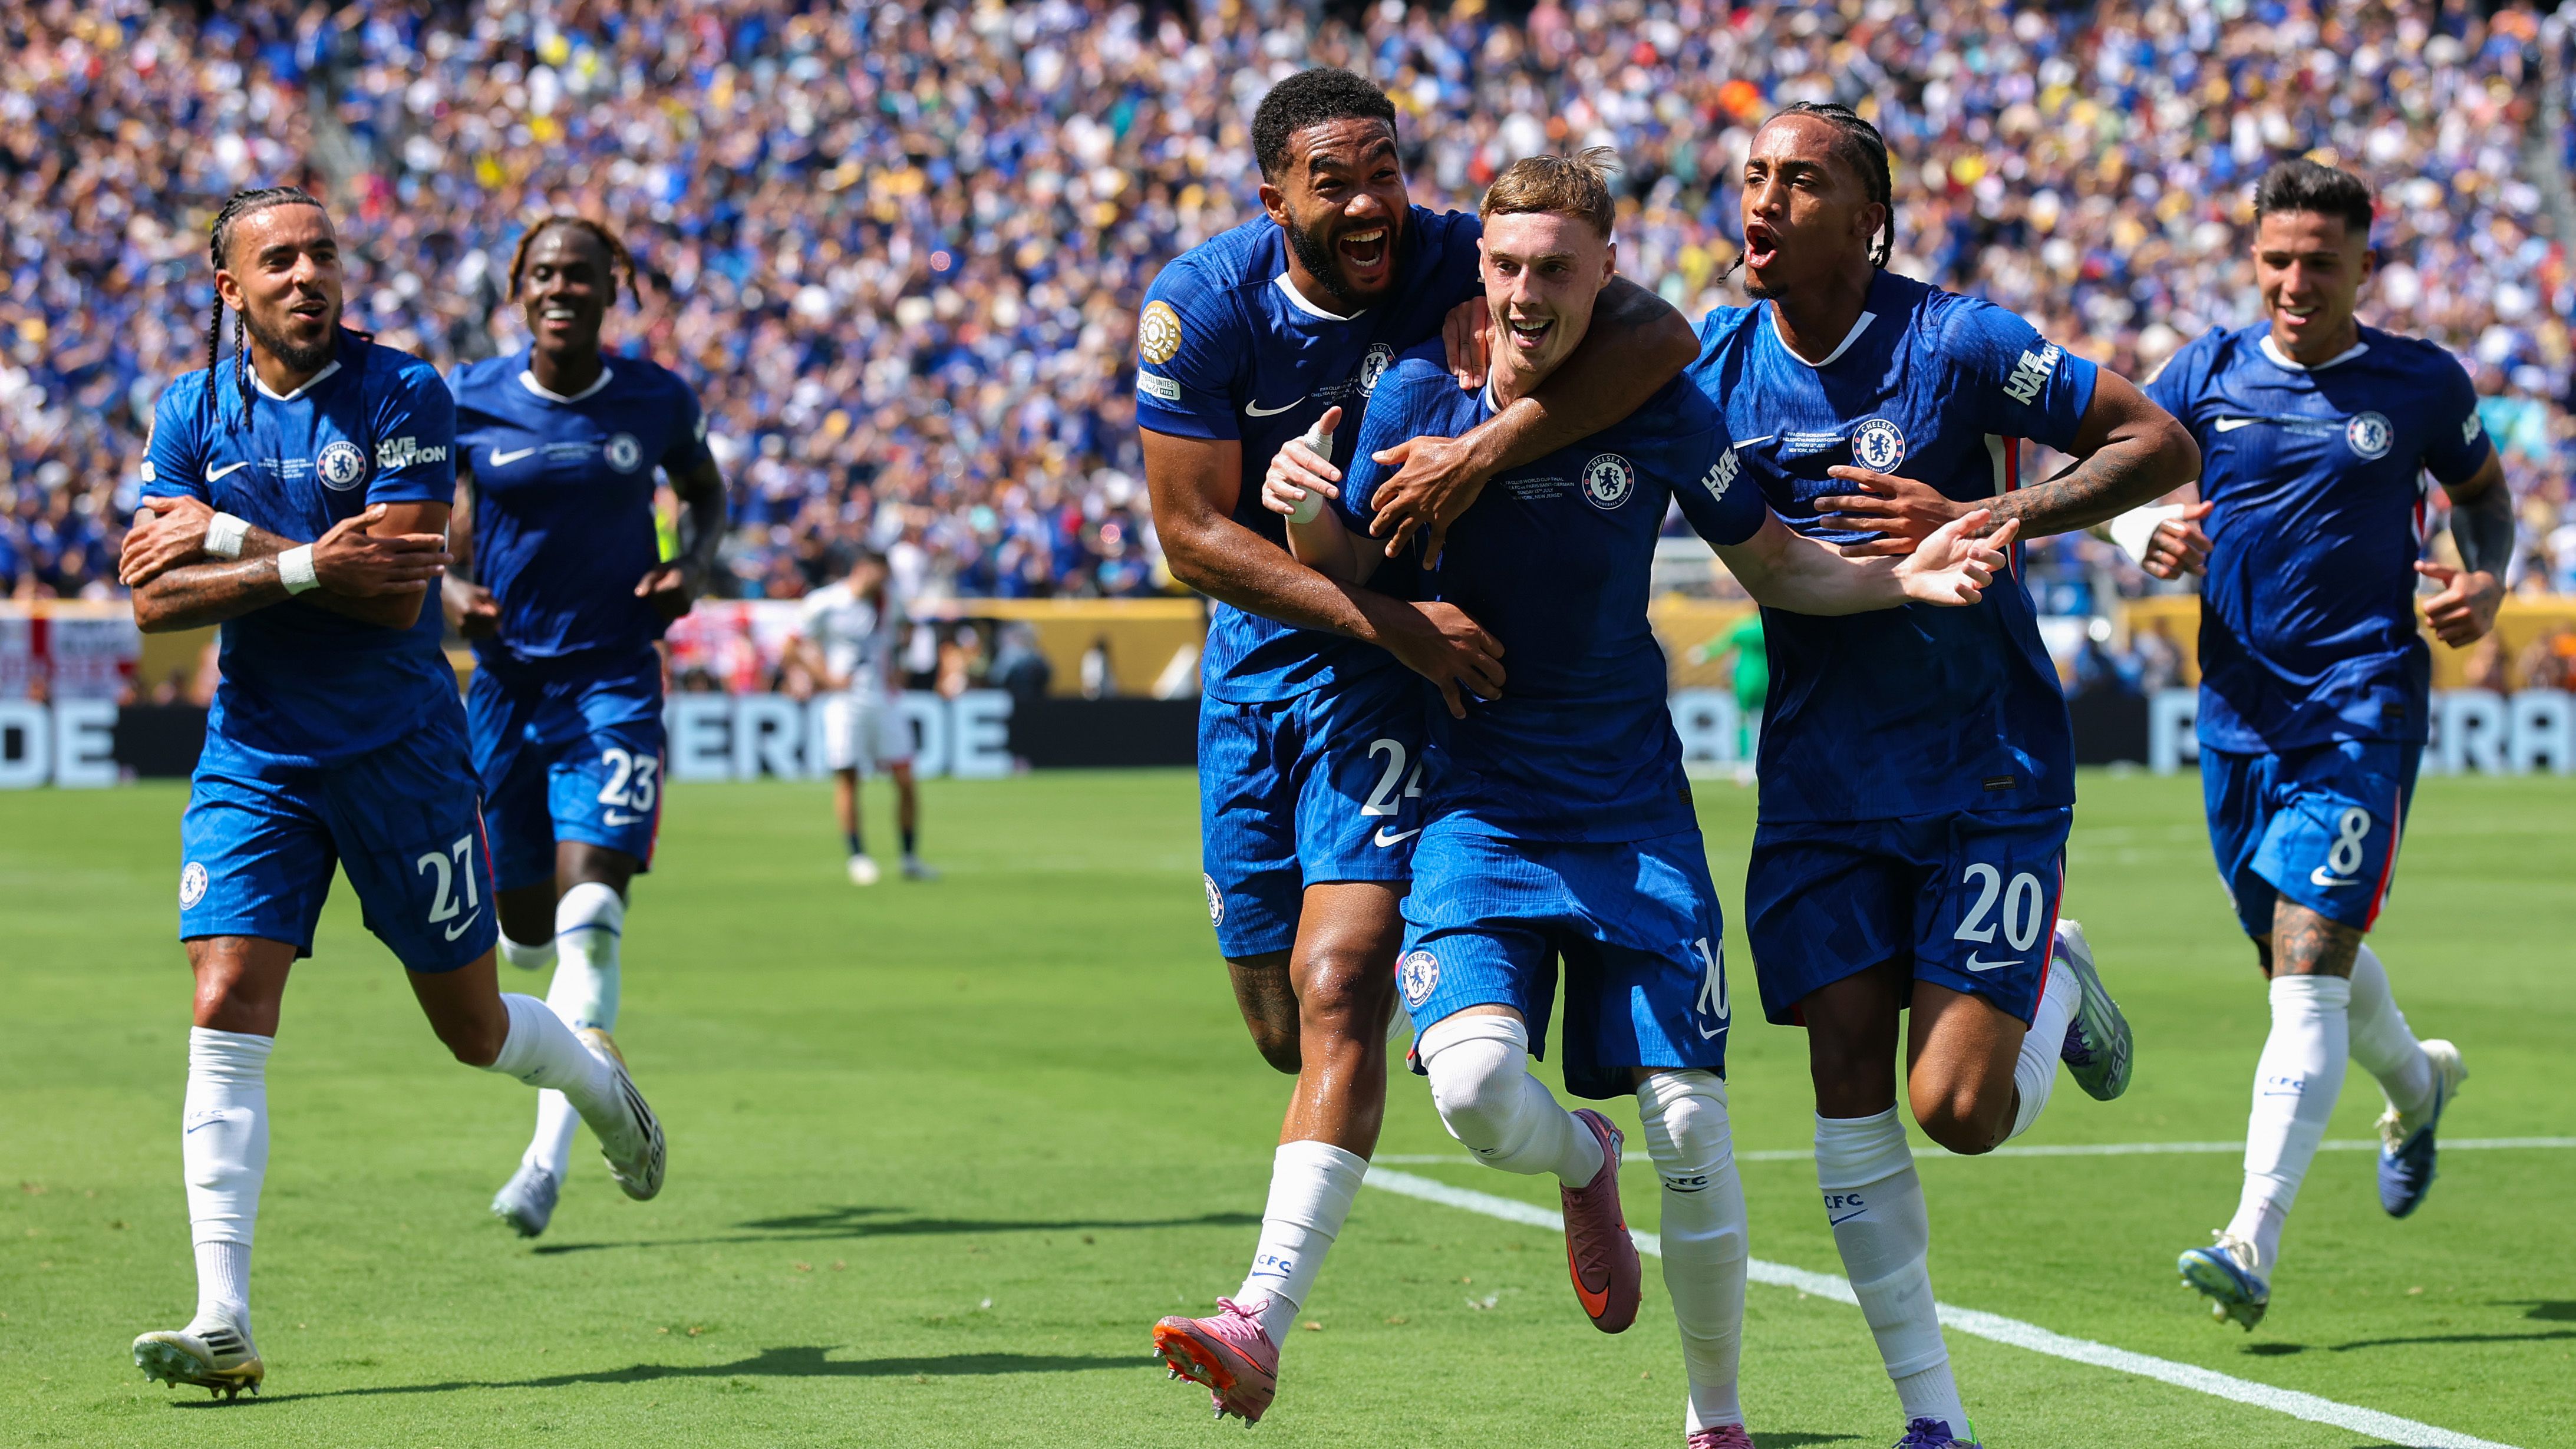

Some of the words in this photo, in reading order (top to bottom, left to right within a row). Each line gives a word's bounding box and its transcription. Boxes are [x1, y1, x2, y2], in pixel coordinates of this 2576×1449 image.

[1143, 307, 1161, 321] WORLD
[1162, 311, 1173, 325] CUP
[1169, 328, 1176, 338] 25
[1143, 346, 1159, 360] FIFA
[1162, 339, 1174, 354] USA
[2003, 349, 2039, 398] LIVE
[1156, 378, 1174, 388] UNITES
[1861, 421, 1895, 434] CHELSEA
[375, 445, 447, 468] NATION
[1588, 456, 1620, 471] CHELSEA
[1701, 446, 1733, 491] LIVE
[1862, 461, 1883, 472] FOOTBALL
[1884, 463, 1895, 471] CLUB
[1710, 454, 1739, 502] NAT
[1618, 491, 1628, 501] CLUB
[597, 747, 658, 813] 23
[2329, 806, 2371, 876] 8
[417, 833, 479, 924] 27
[1954, 863, 2043, 951] 20
[1403, 953, 1426, 976] CHELSEA
[1695, 937, 1729, 1019] 10
[1426, 982, 1434, 993] CLUB
[1824, 1193, 1864, 1209] CFC
[1258, 1255, 1292, 1273] CFC
